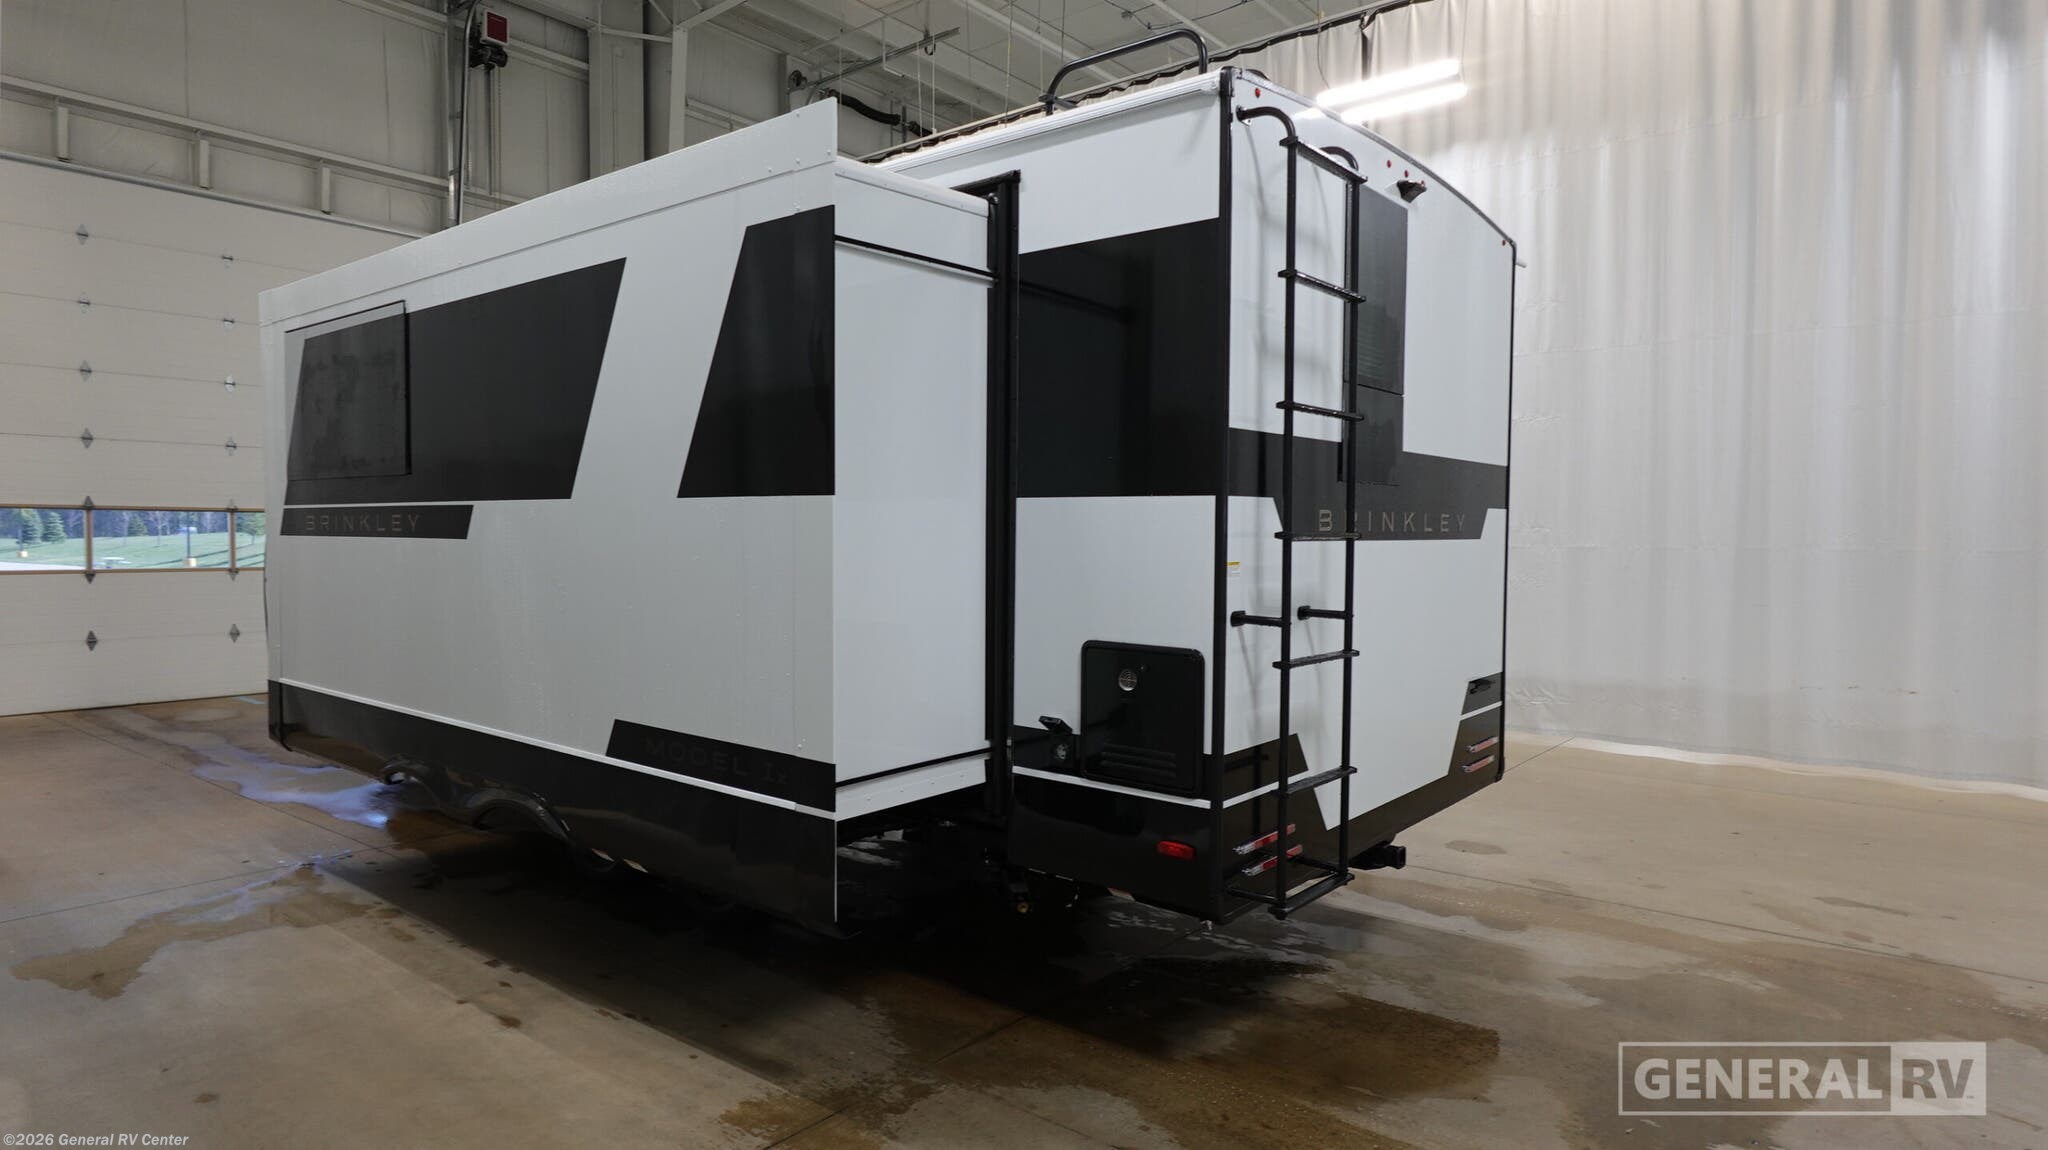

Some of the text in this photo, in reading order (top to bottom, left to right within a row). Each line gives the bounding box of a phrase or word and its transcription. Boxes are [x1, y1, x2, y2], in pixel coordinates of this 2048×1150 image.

[306, 514, 420, 532] BRINKLEY
[1318, 509, 1466, 533] BINKLEY
[645, 736, 748, 776] MODEL
